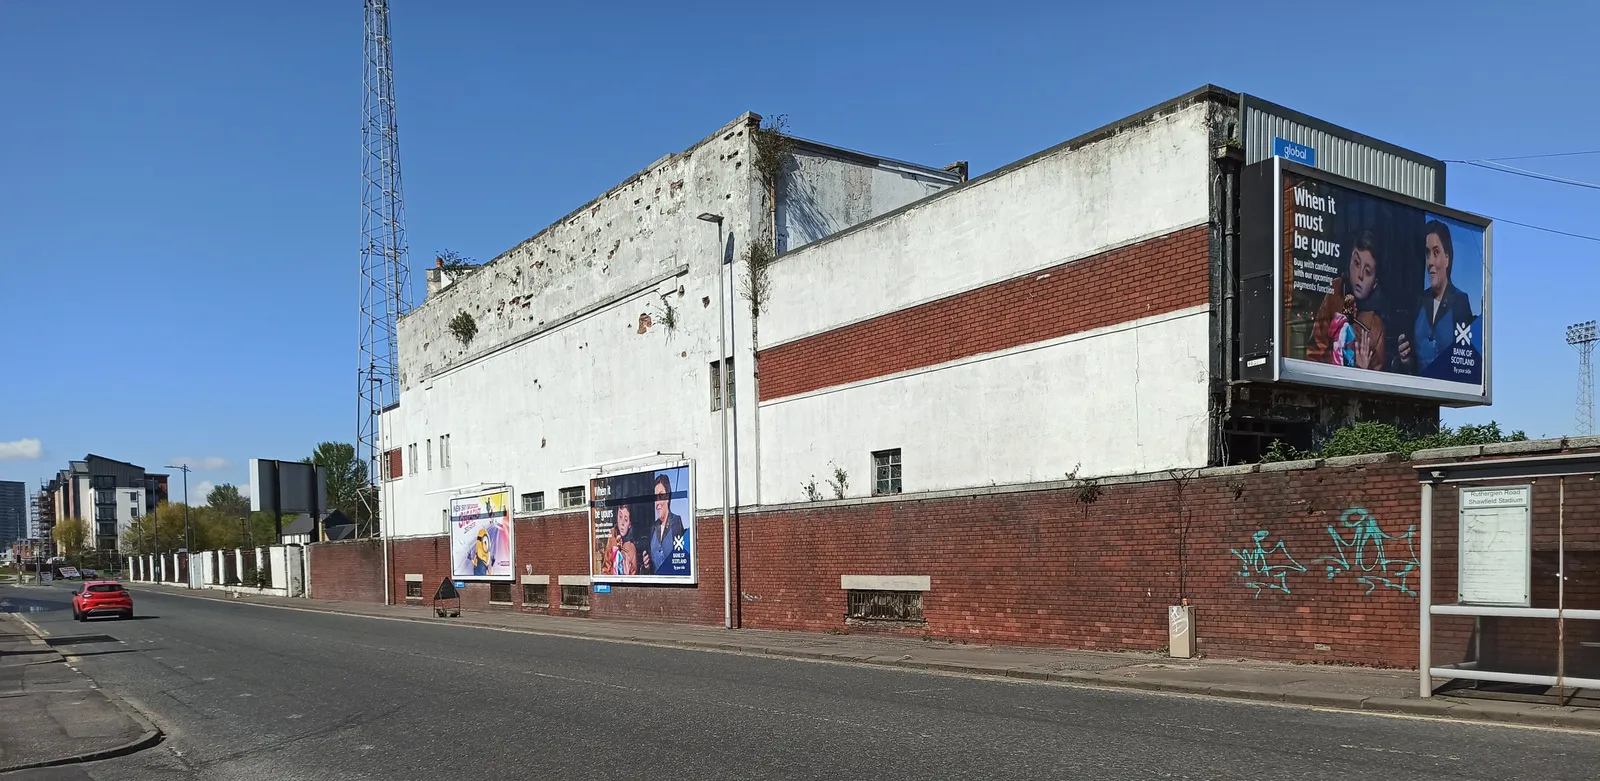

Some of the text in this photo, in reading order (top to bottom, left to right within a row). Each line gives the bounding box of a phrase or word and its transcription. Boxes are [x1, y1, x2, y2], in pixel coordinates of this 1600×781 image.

[1284, 144, 1306, 160] global
[1294, 186, 1336, 214] When it
[1294, 212, 1324, 232] must
[1294, 230, 1340, 258] be yours
[1294, 258, 1338, 274] Buy with confidence
[1294, 269, 1304, 278] with
[1313, 273, 1333, 286] upcoming
[1294, 280, 1334, 294] payments function
[1453, 348, 1465, 356] BANK
[1451, 356, 1475, 366] SCOTLAND
[594, 486, 606, 496] When
[595, 509, 613, 521] be yours
